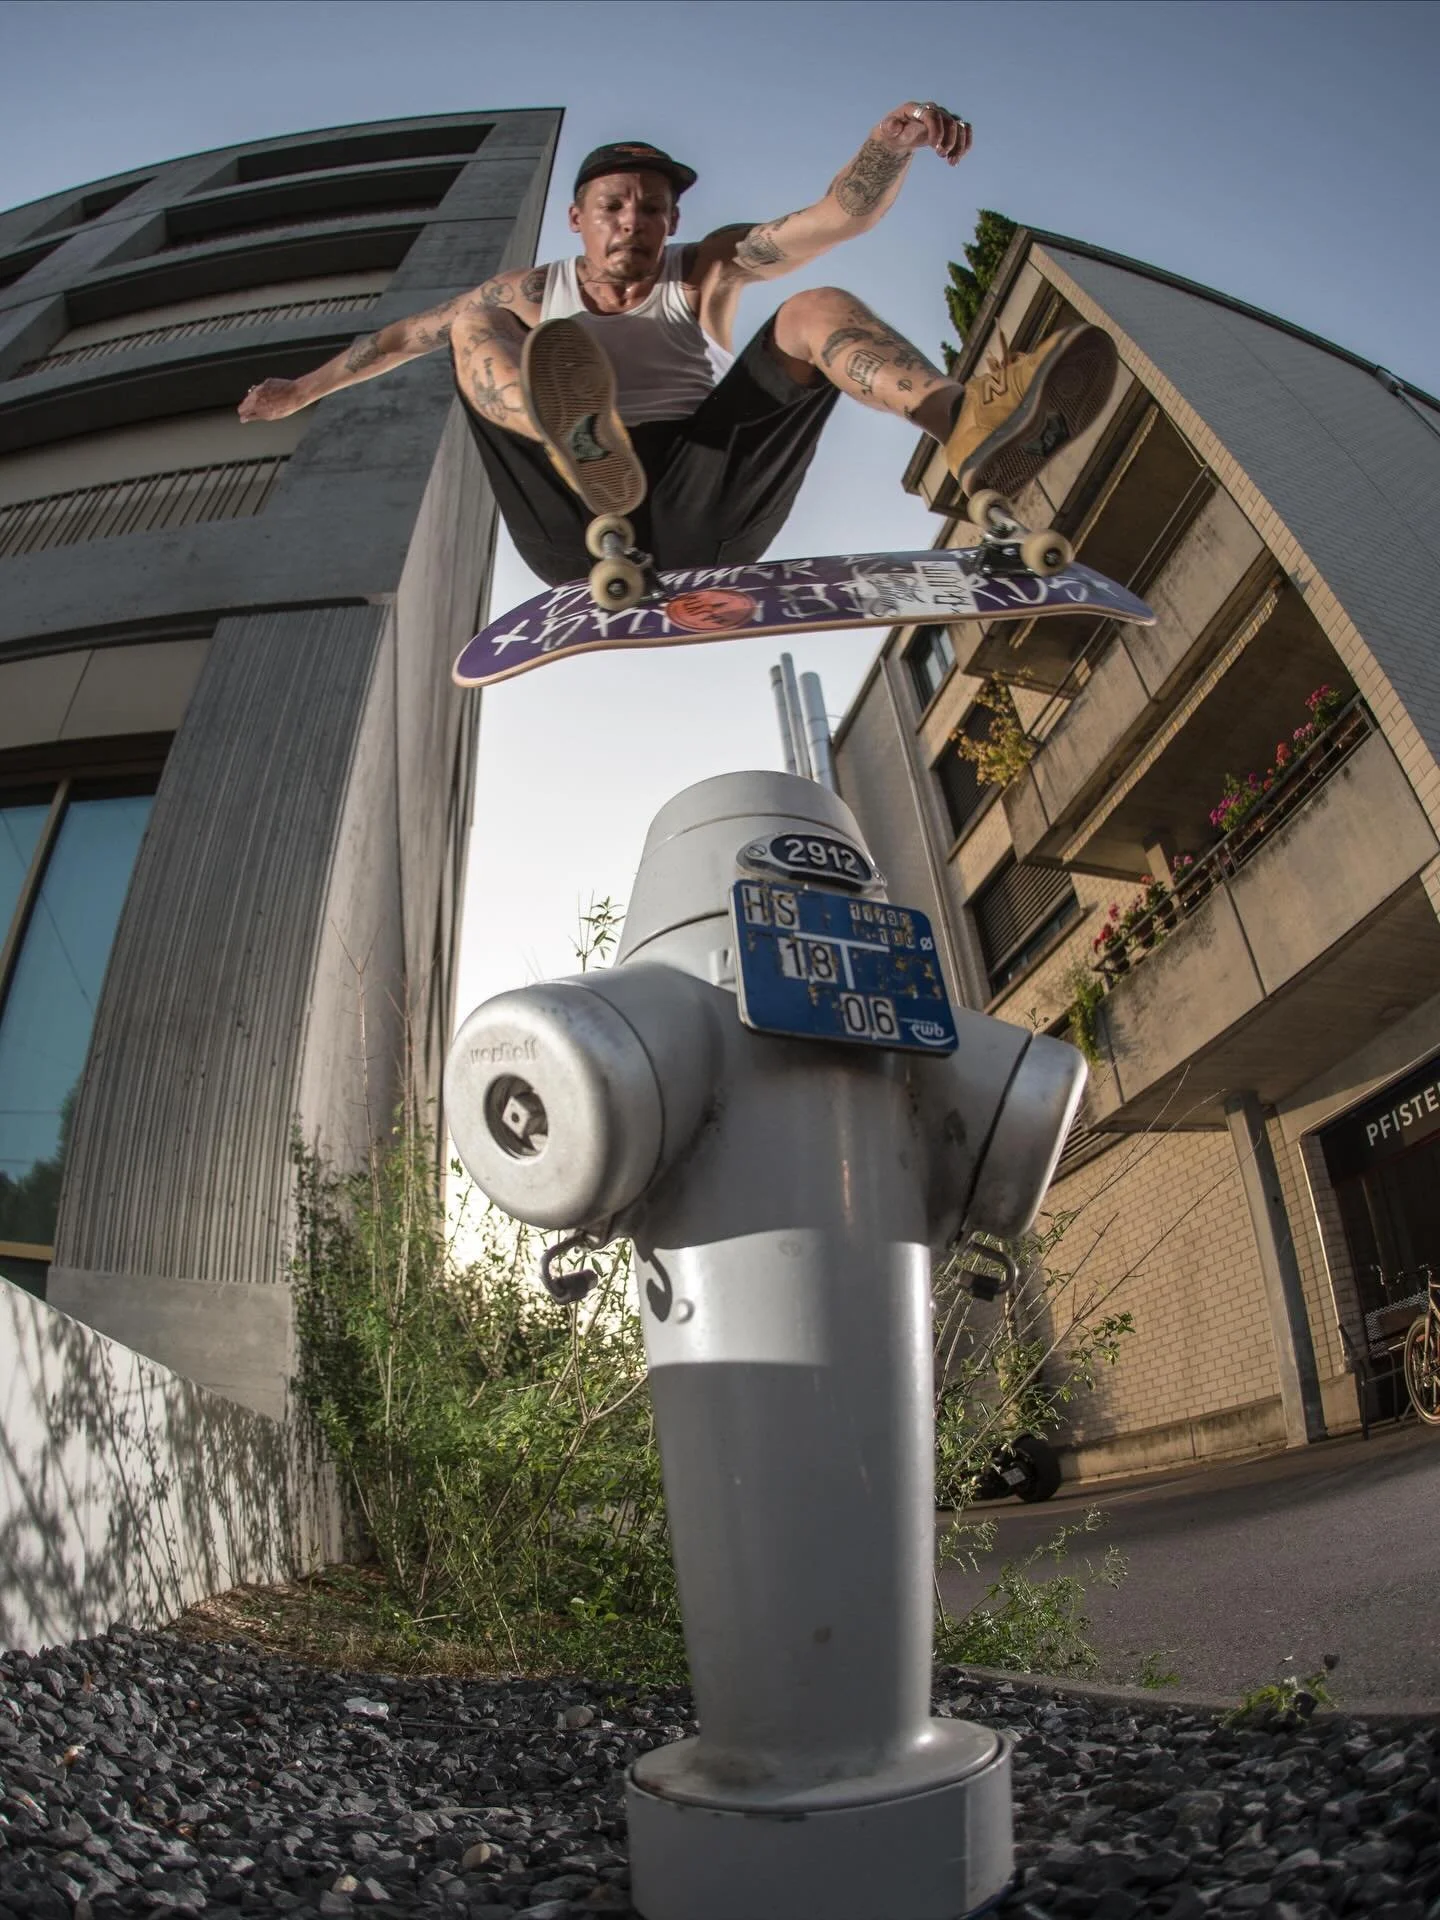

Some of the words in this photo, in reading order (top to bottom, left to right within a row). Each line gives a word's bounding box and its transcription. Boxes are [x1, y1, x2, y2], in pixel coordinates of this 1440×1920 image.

[785, 839, 860, 876] 2912
[744, 887, 796, 926] HS
[786, 943, 833, 979] 18
[844, 996, 895, 1035] 06
[1365, 1082, 1440, 1147] PFISTE
